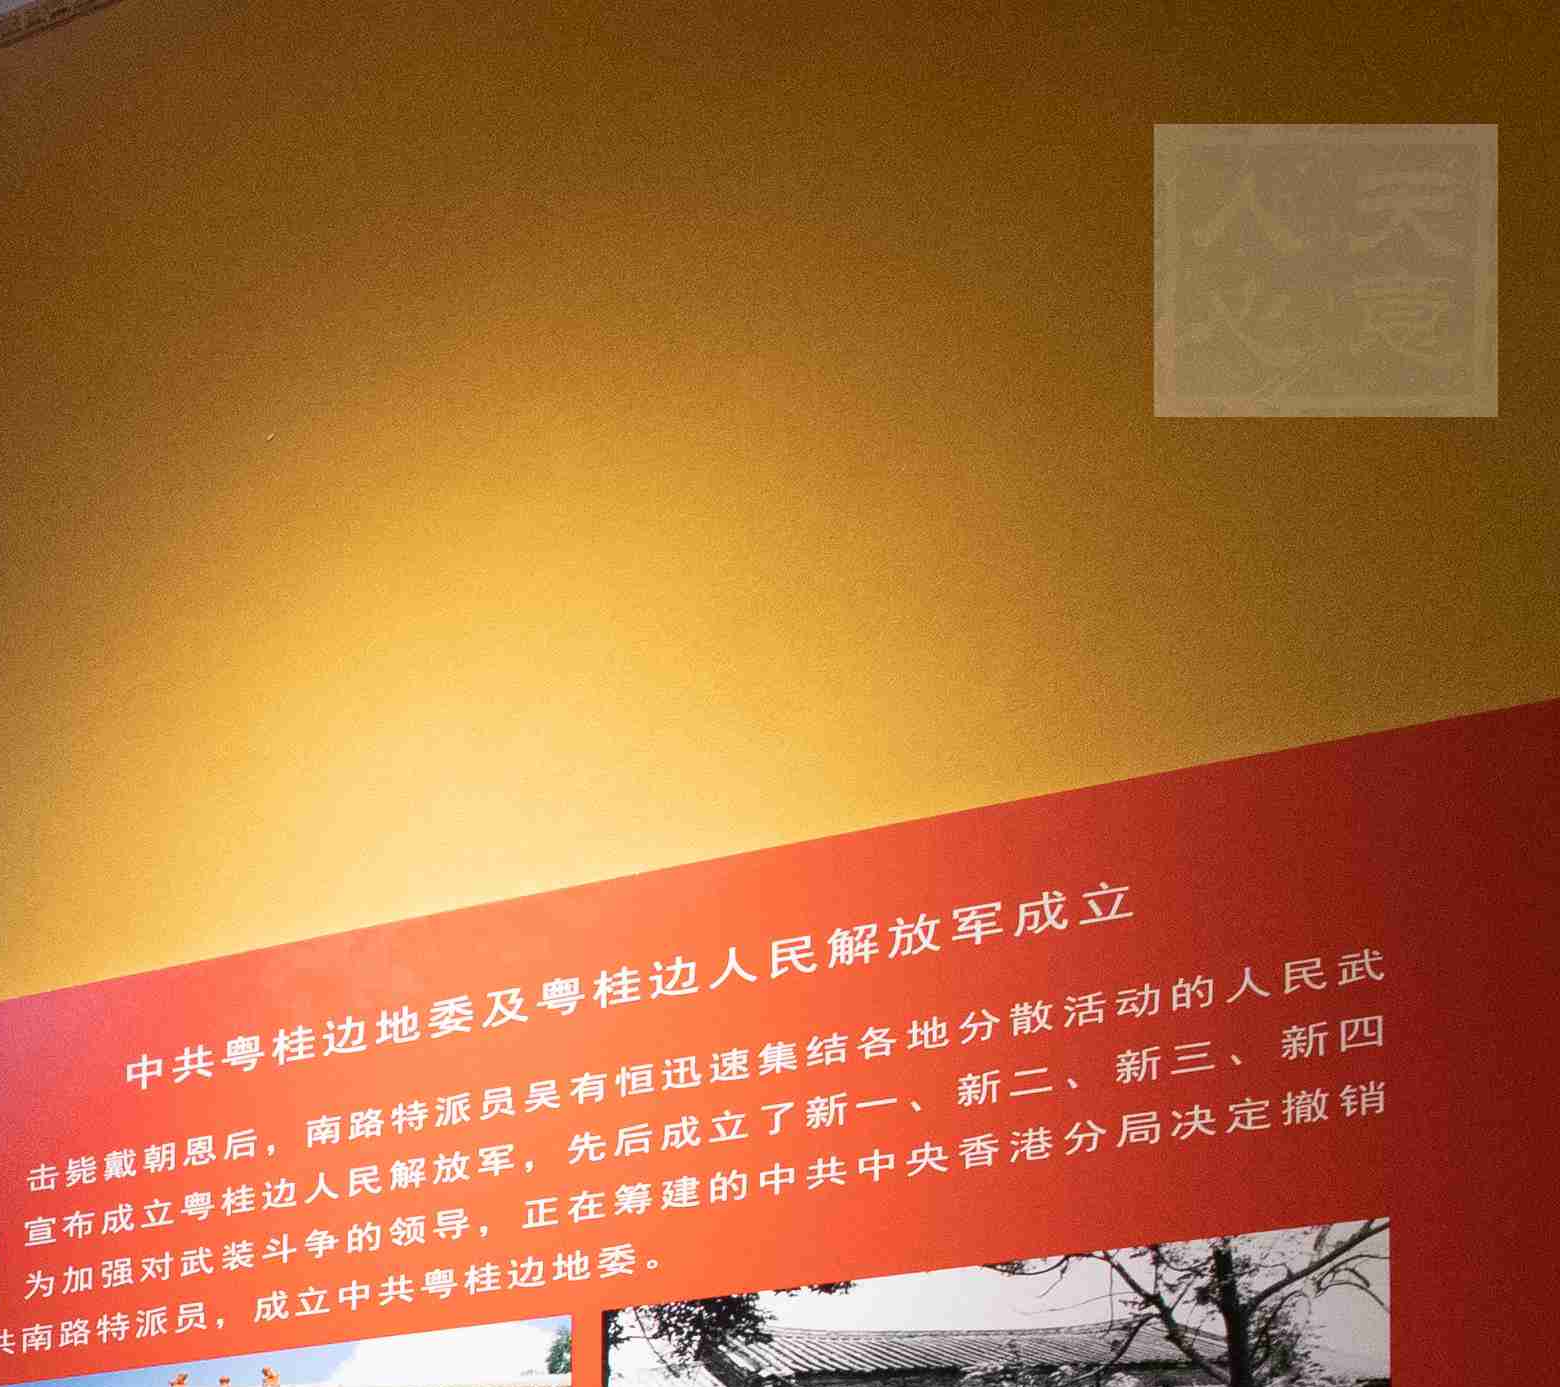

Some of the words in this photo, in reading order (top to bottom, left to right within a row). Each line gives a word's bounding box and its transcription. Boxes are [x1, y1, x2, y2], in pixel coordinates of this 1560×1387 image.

[125, 880, 1135, 1092] 中共粤桂边地委及粤桂边人民解放军成立
